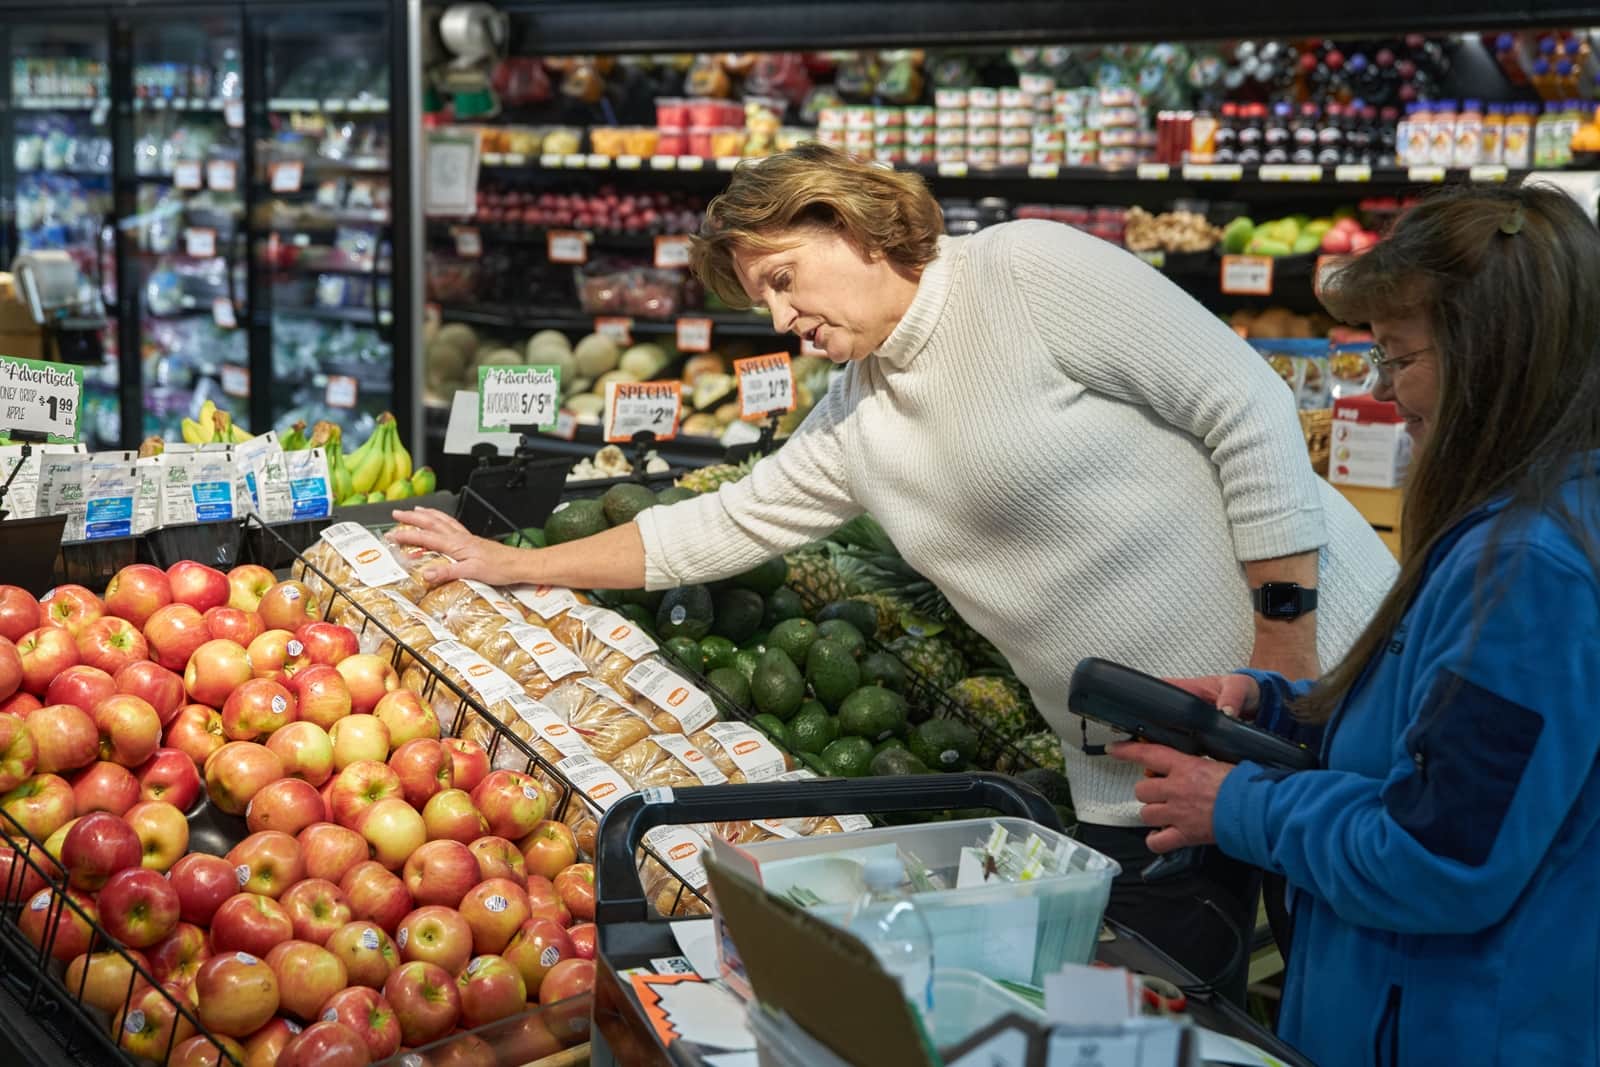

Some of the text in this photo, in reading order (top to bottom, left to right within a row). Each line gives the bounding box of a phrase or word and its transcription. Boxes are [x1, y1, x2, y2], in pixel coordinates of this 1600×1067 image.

[10, 363, 74, 387] Advertised
[497, 370, 552, 385] Advertised
[0, 385, 17, 401] ONEY
[619, 385, 675, 400] SPECIAL
[6, 406, 25, 420] APPLE
